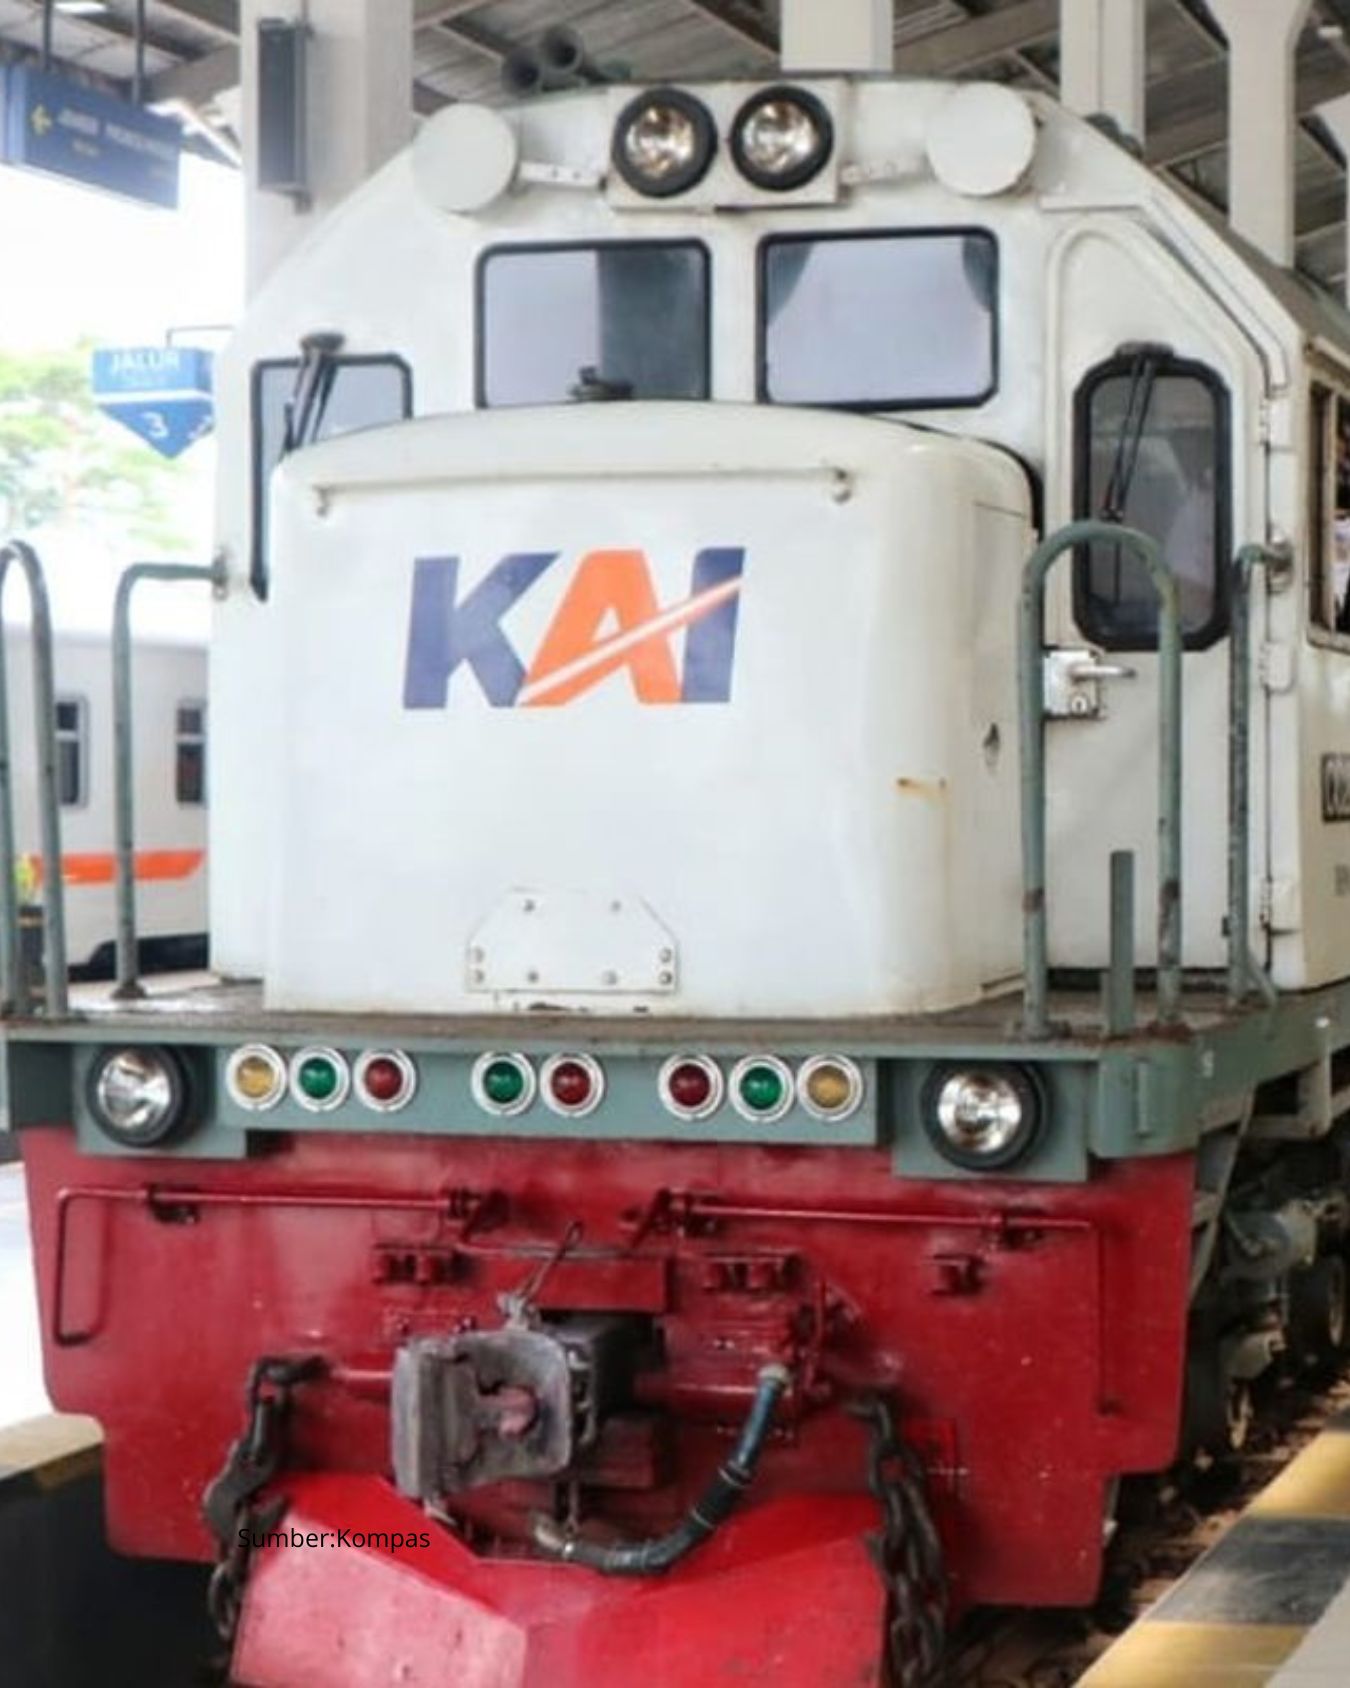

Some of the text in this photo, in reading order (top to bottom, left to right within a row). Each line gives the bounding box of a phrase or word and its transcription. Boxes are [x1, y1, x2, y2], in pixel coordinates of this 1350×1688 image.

[110, 349, 179, 376] JALUR
[141, 411, 168, 439] 3
[402, 546, 746, 710] KAI
